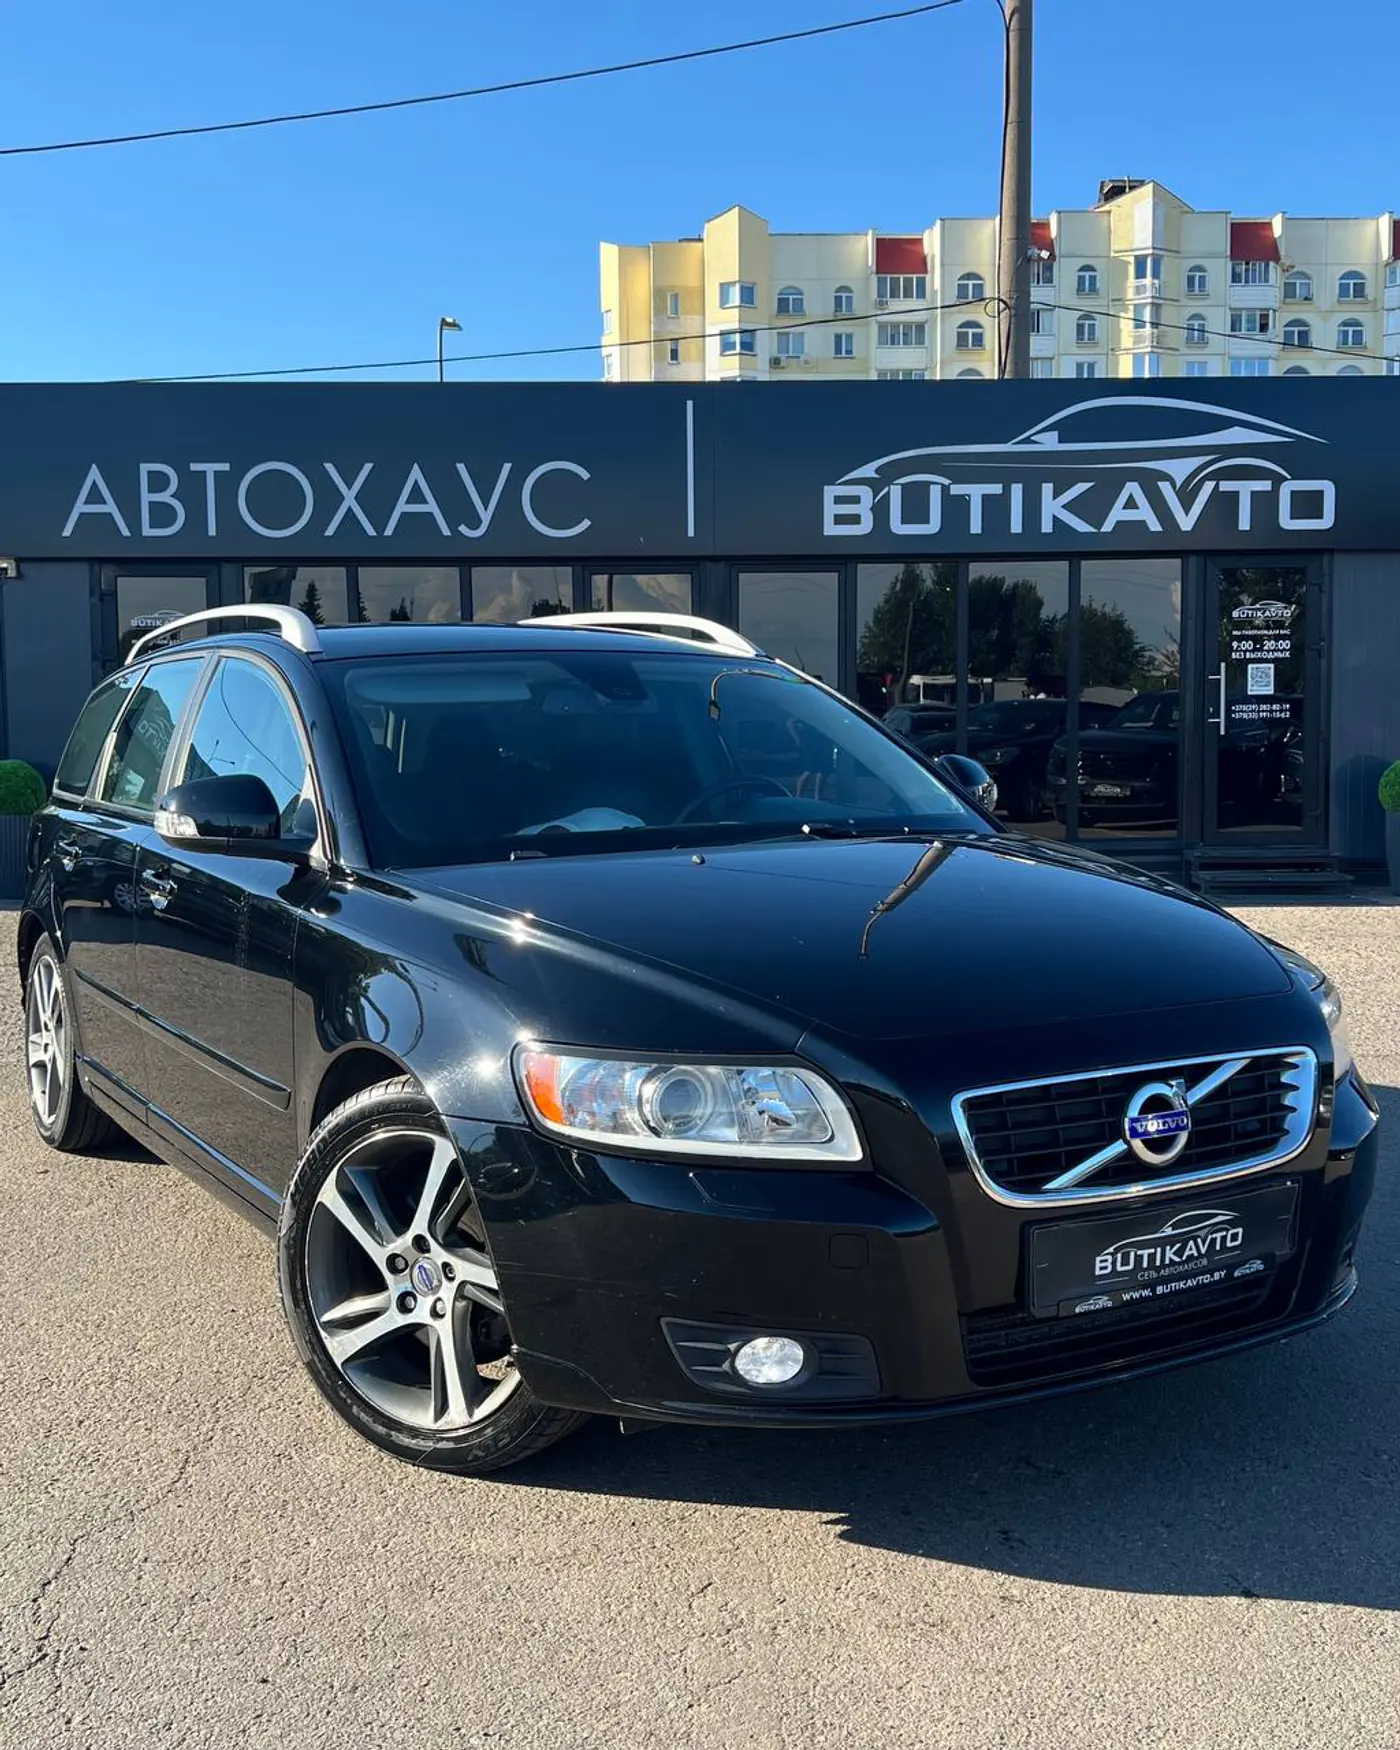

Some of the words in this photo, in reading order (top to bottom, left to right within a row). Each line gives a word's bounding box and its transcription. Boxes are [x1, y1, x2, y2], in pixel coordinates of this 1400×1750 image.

[61, 461, 593, 538] АВТОХАУС
[822, 479, 1337, 537] BUTIKAVTO
[1231, 609, 1292, 618] BUTIKAVTO
[1231, 641, 1253, 651] 9:00
[1263, 640, 1291, 650] 20:00
[1231, 651, 1244, 659] БЕЗ
[1246, 651, 1291, 659] ВЫХОДНЫХ
[1131, 1115, 1188, 1133] VOLVO
[1094, 1227, 1243, 1276] BUTIKAVTO
[1137, 1269, 1158, 1281] СЕТЬ
[1121, 1287, 1153, 1301] WWW.
[1156, 1269, 1227, 1295] BUTIKAVTO.BY
